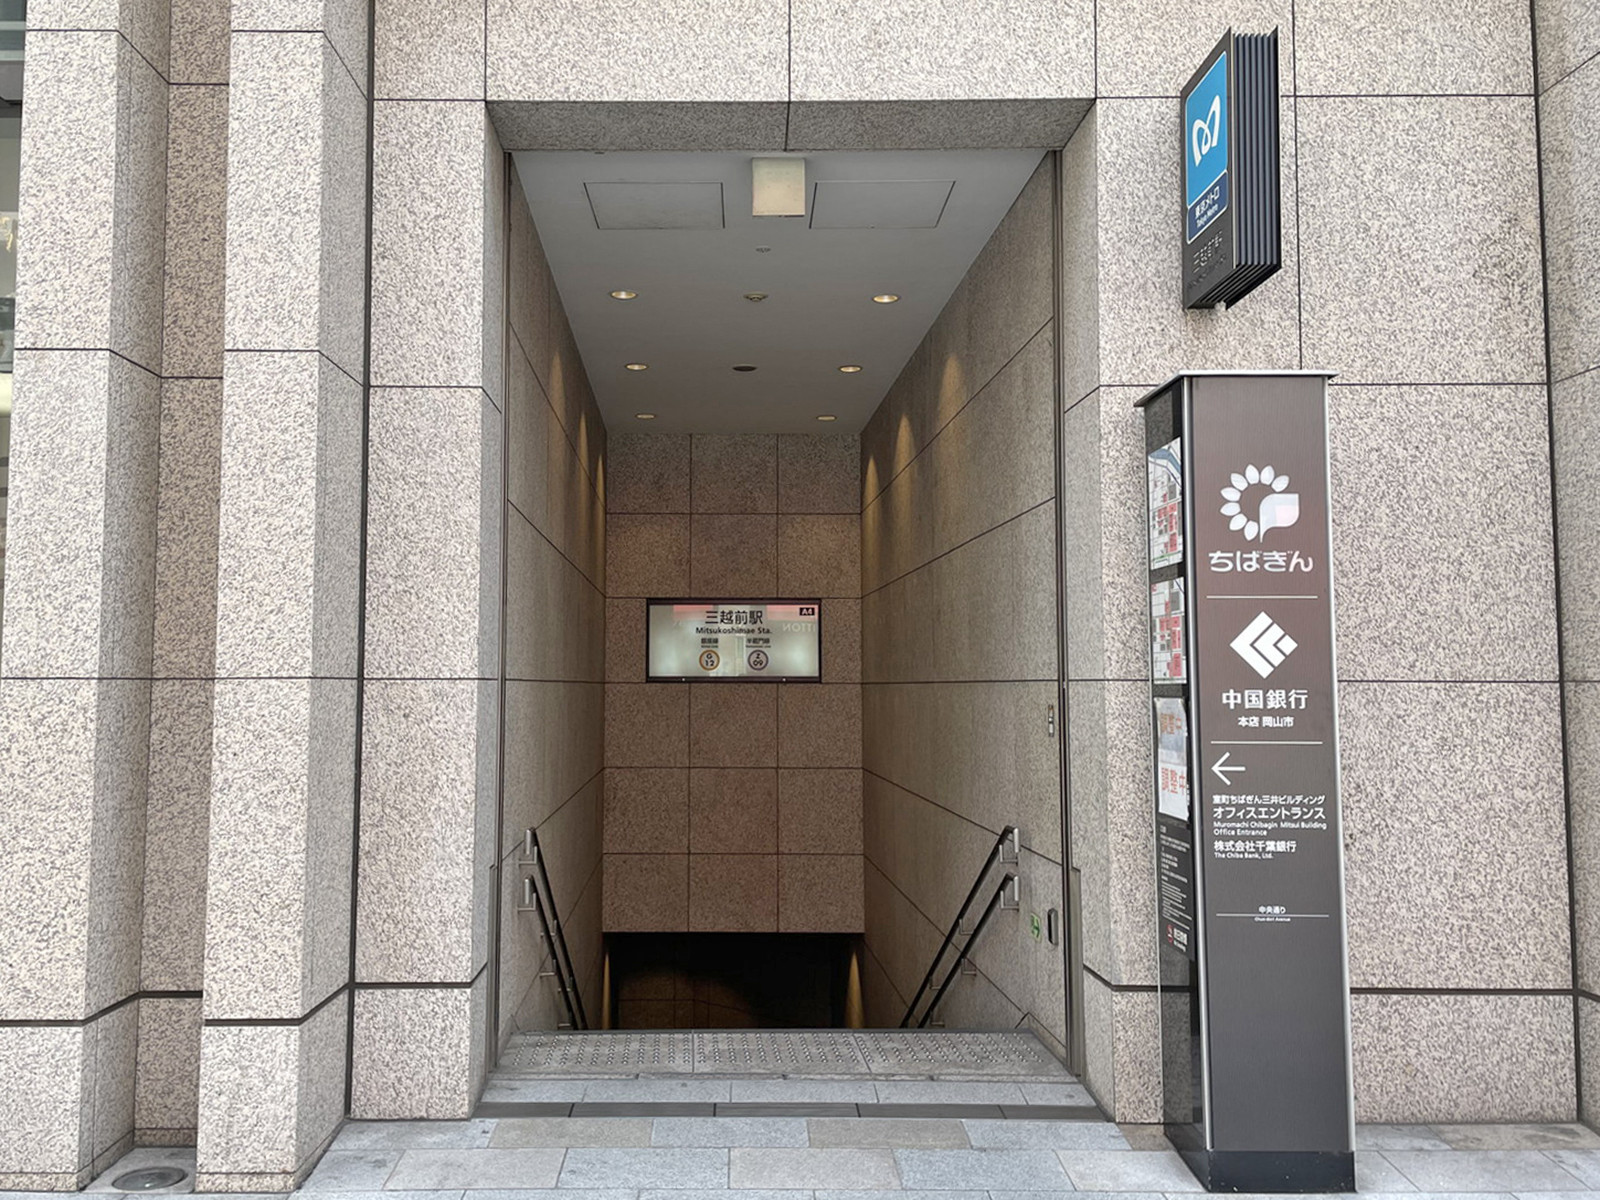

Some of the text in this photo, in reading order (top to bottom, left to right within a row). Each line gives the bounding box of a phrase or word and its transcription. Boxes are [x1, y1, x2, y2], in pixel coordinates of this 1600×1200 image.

[1208, 551, 1314, 573] ちばぎん
[705, 610, 763, 625] 三越前駅
[1221, 689, 1309, 710] 中国銀行
[1237, 716, 1295, 728] 本店 岡山市
[1213, 807, 1326, 819] オフィスエントランス
[1250, 822, 1278, 830] Chibagin
[1301, 822, 1327, 830] Building
[1213, 841, 1297, 853] 株式会社千葉銀行
[1258, 906, 1286, 914] 中央通り
